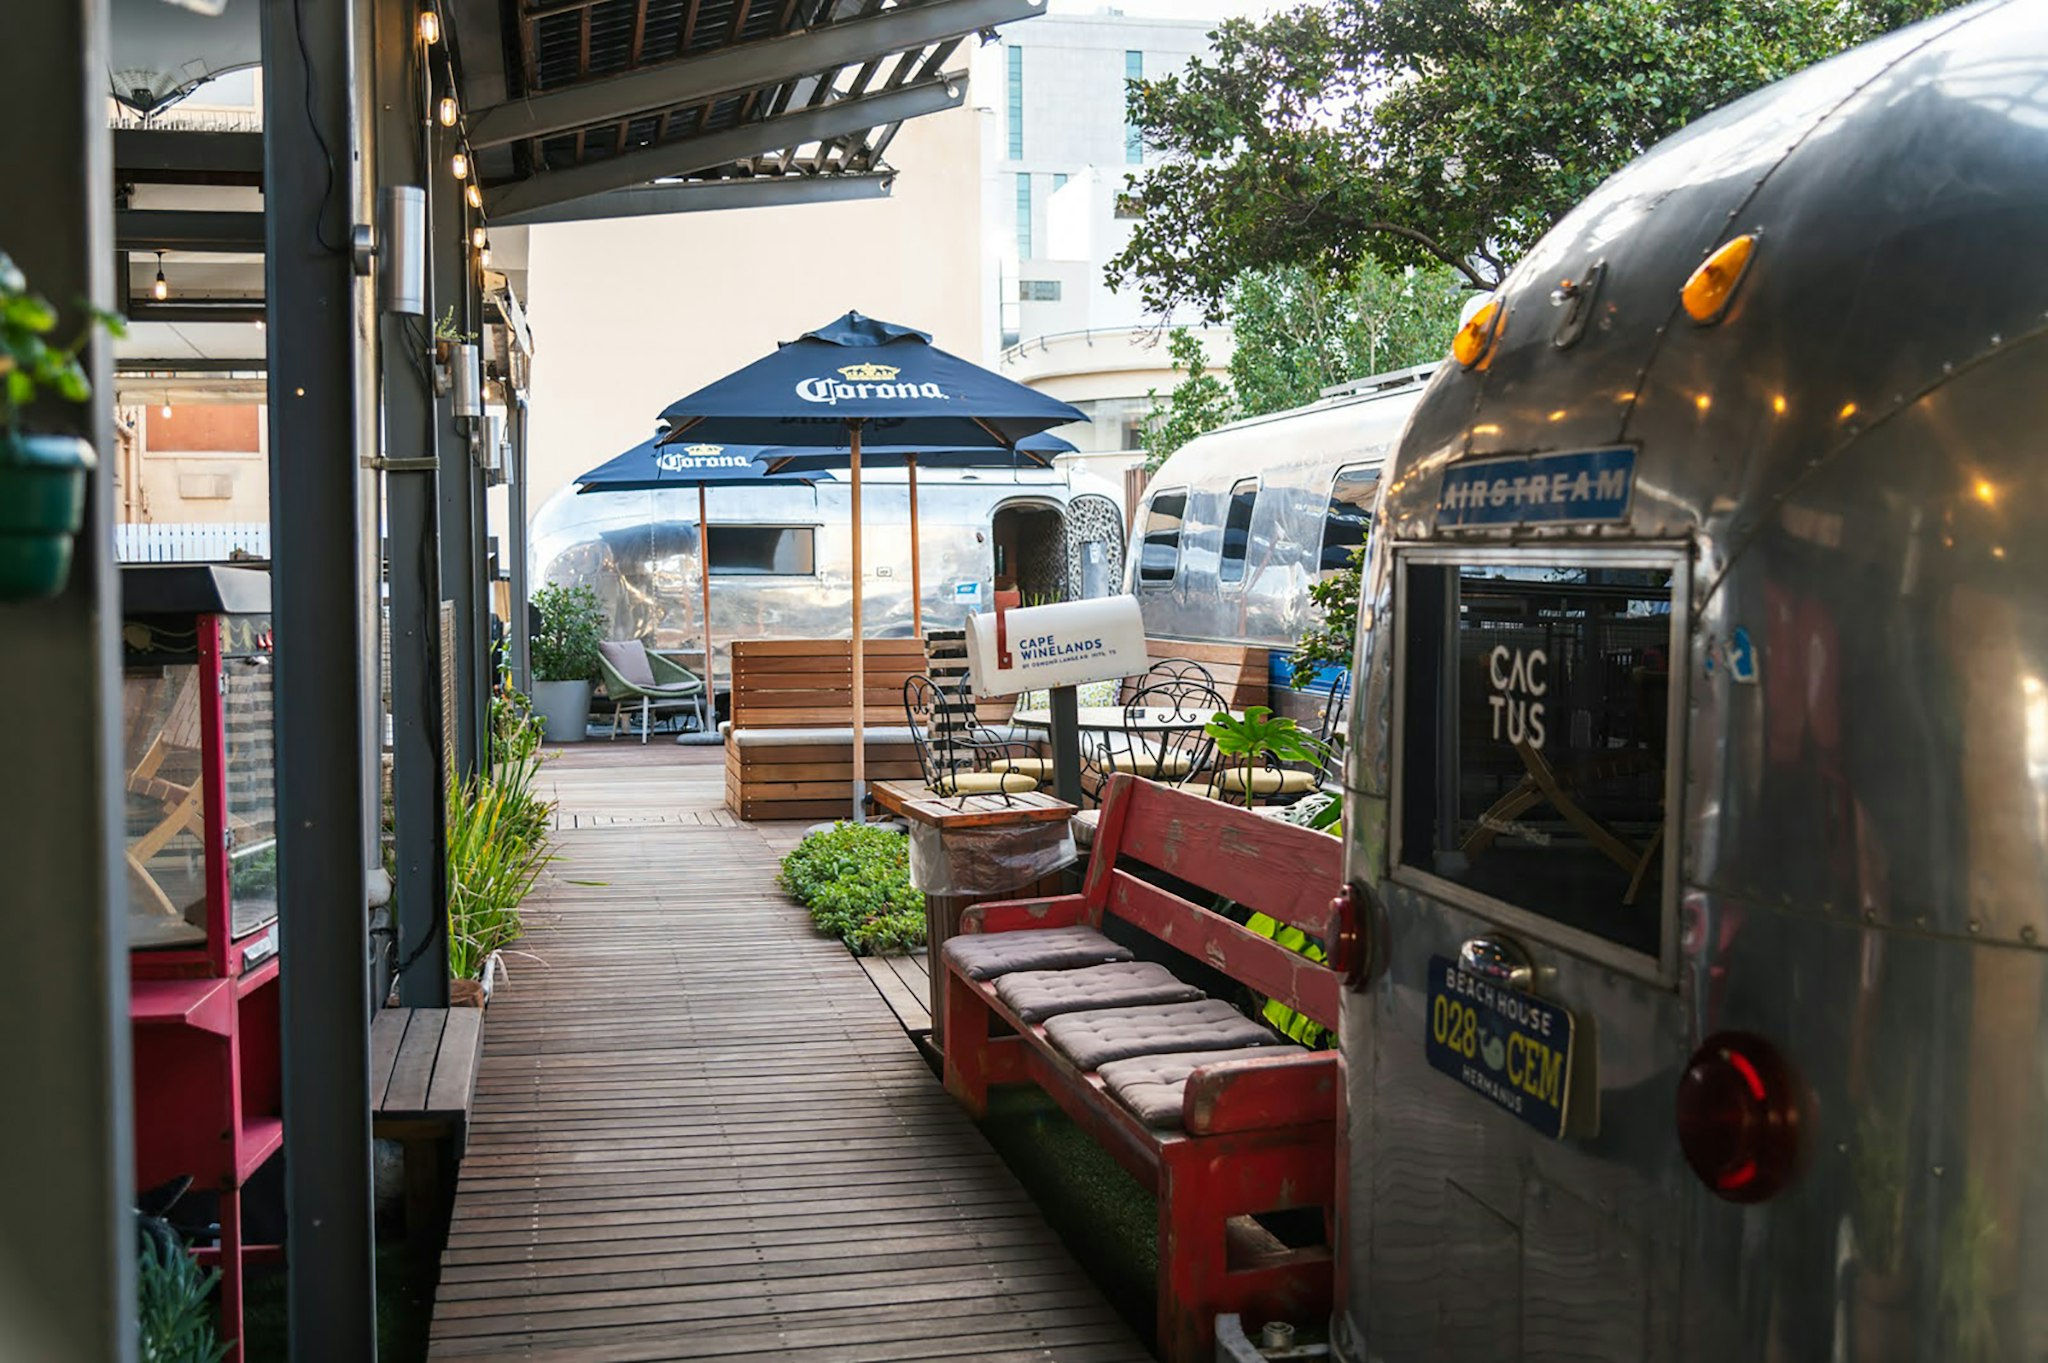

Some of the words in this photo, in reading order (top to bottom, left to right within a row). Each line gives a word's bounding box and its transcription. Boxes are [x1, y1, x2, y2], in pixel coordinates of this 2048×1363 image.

[1442, 469, 1626, 511] AIRSTREAM
[1019, 635, 1055, 650] CAPE
[1020, 638, 1102, 660] WINELANDS
[1489, 645, 1548, 697] CAC
[1488, 695, 1546, 750] TUS
[1446, 967, 1494, 1009] BEACH
[1497, 994, 1553, 1037] HOUSE
[1433, 993, 1478, 1060] 028
[1506, 1030, 1564, 1109] CEM
[1461, 1065, 1524, 1115] HERMANUS
